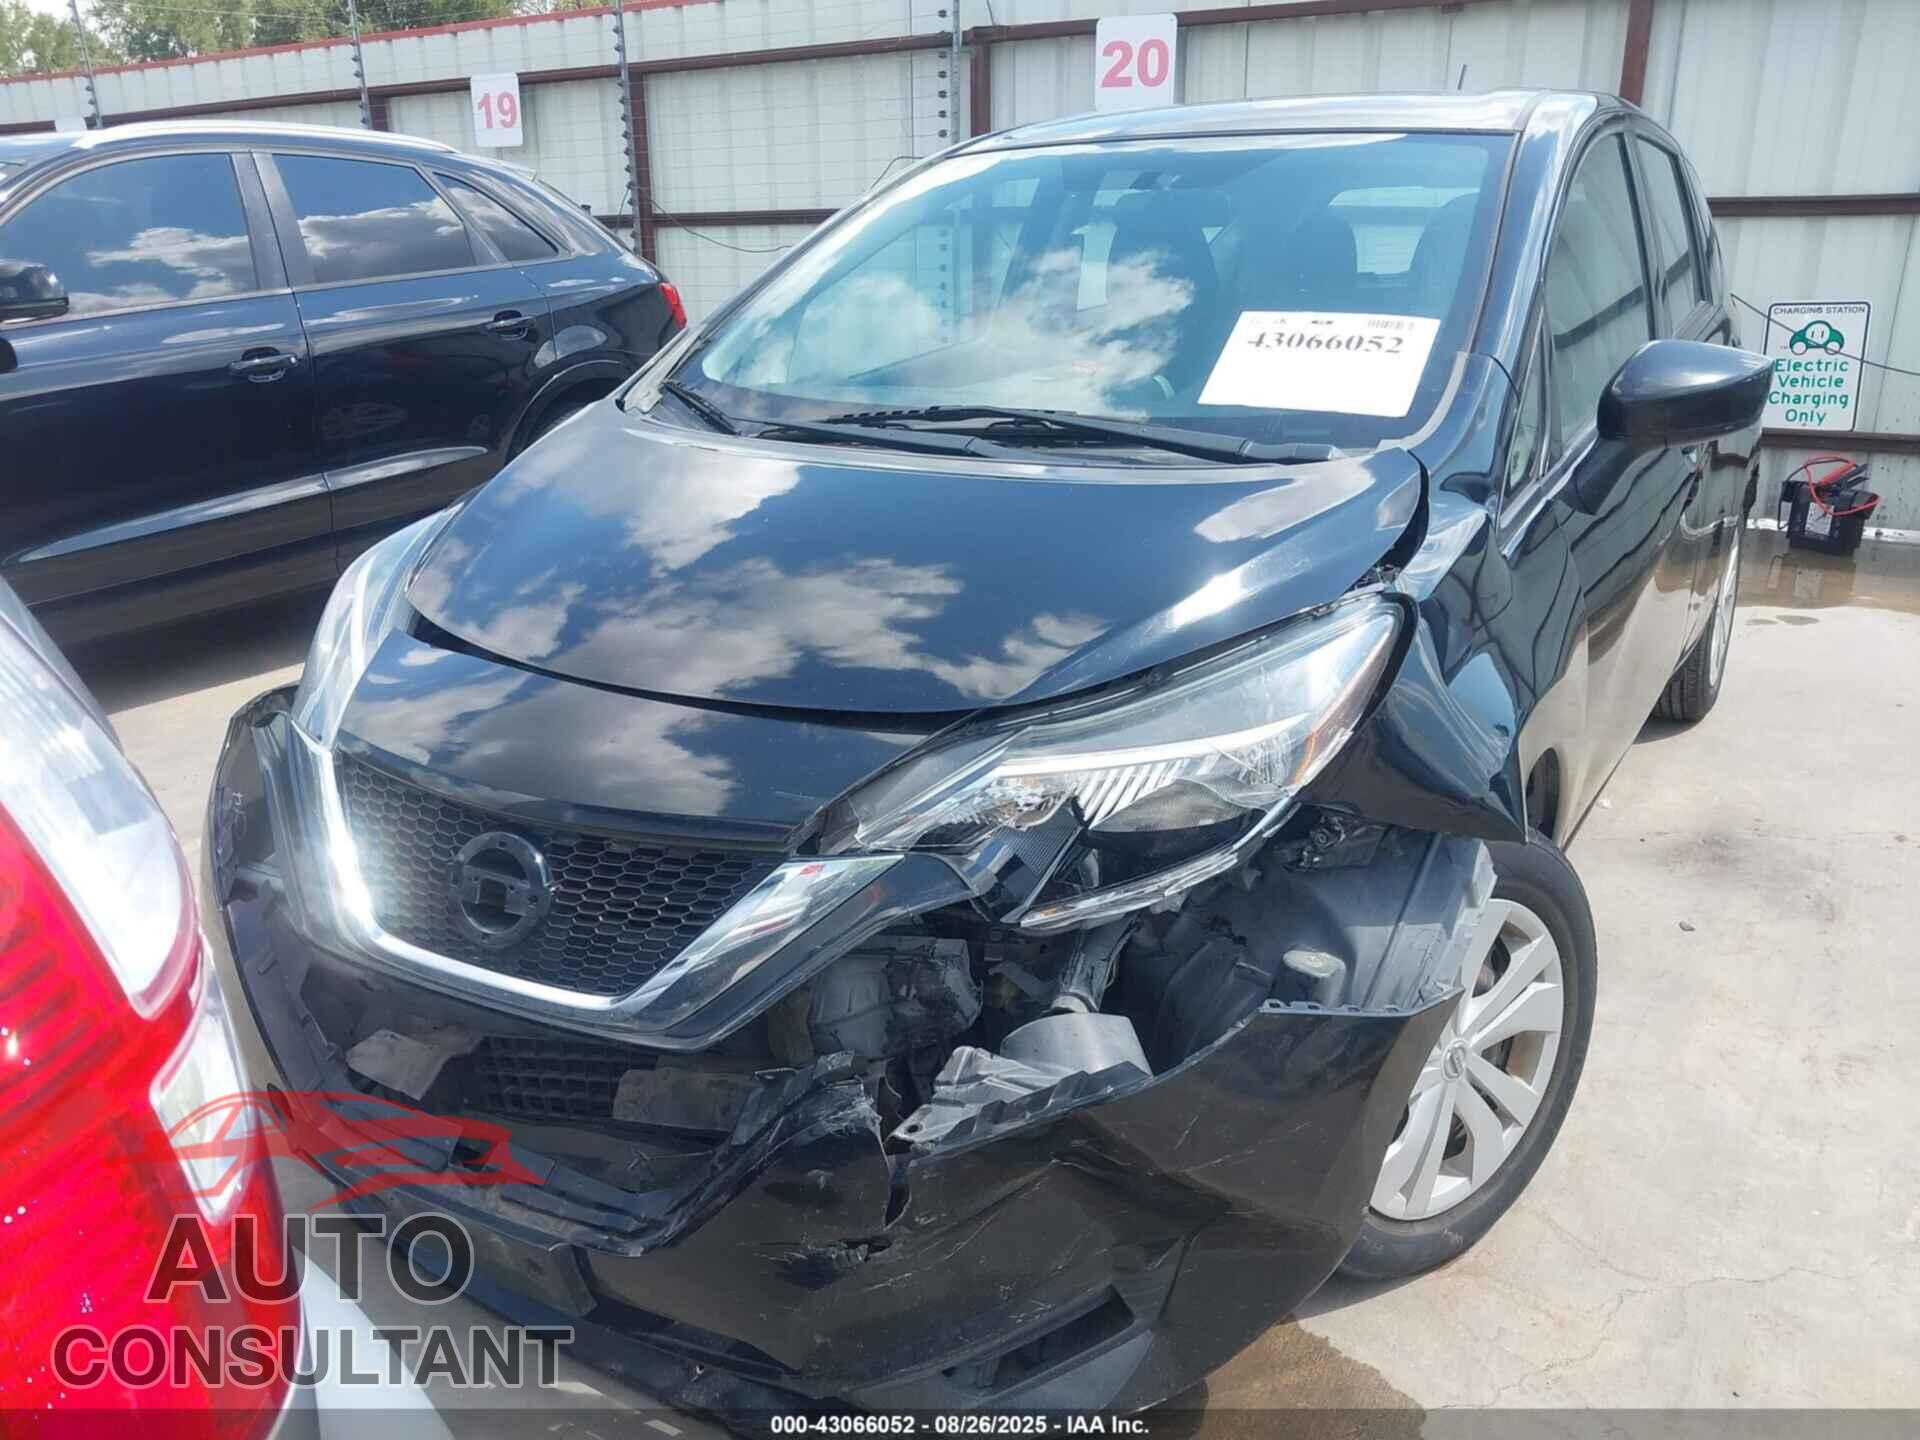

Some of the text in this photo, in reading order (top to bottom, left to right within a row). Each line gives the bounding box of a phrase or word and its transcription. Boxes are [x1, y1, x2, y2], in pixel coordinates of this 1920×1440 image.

[1101, 38, 1169, 88] 20
[477, 91, 518, 129] 19
[1773, 305, 1866, 314] CHARGING STATION
[1247, 331, 1404, 354] 43066052
[1774, 357, 1849, 372] Electric
[1777, 374, 1844, 388] Vehicle
[1768, 391, 1849, 408] Charging
[1785, 408, 1826, 426] Only
